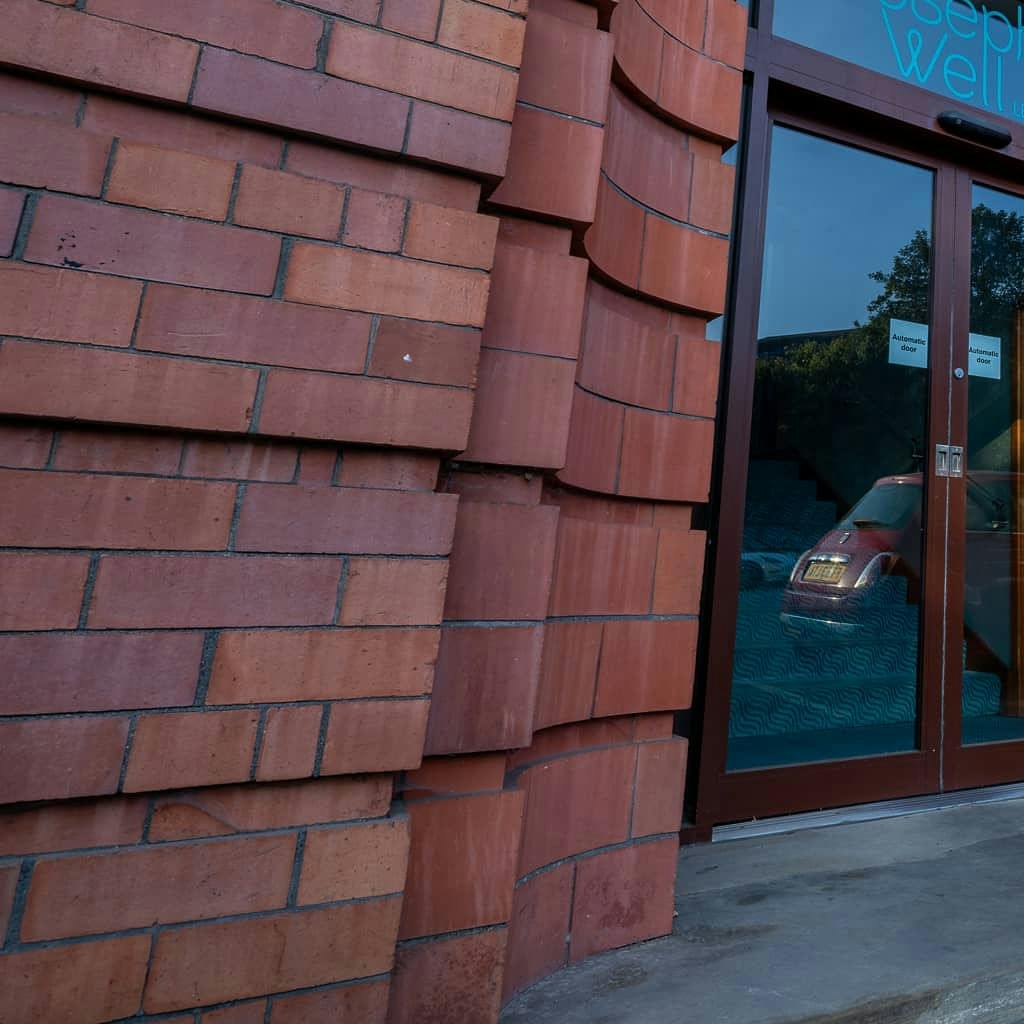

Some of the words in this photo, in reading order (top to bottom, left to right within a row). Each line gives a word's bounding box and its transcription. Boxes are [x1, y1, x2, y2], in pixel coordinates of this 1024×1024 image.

[881, 6, 1004, 112] Well
[892, 333, 926, 346] Automatic
[901, 345, 917, 353] door
[968, 346, 1000, 358] Automatic
[976, 357, 992, 365] door
